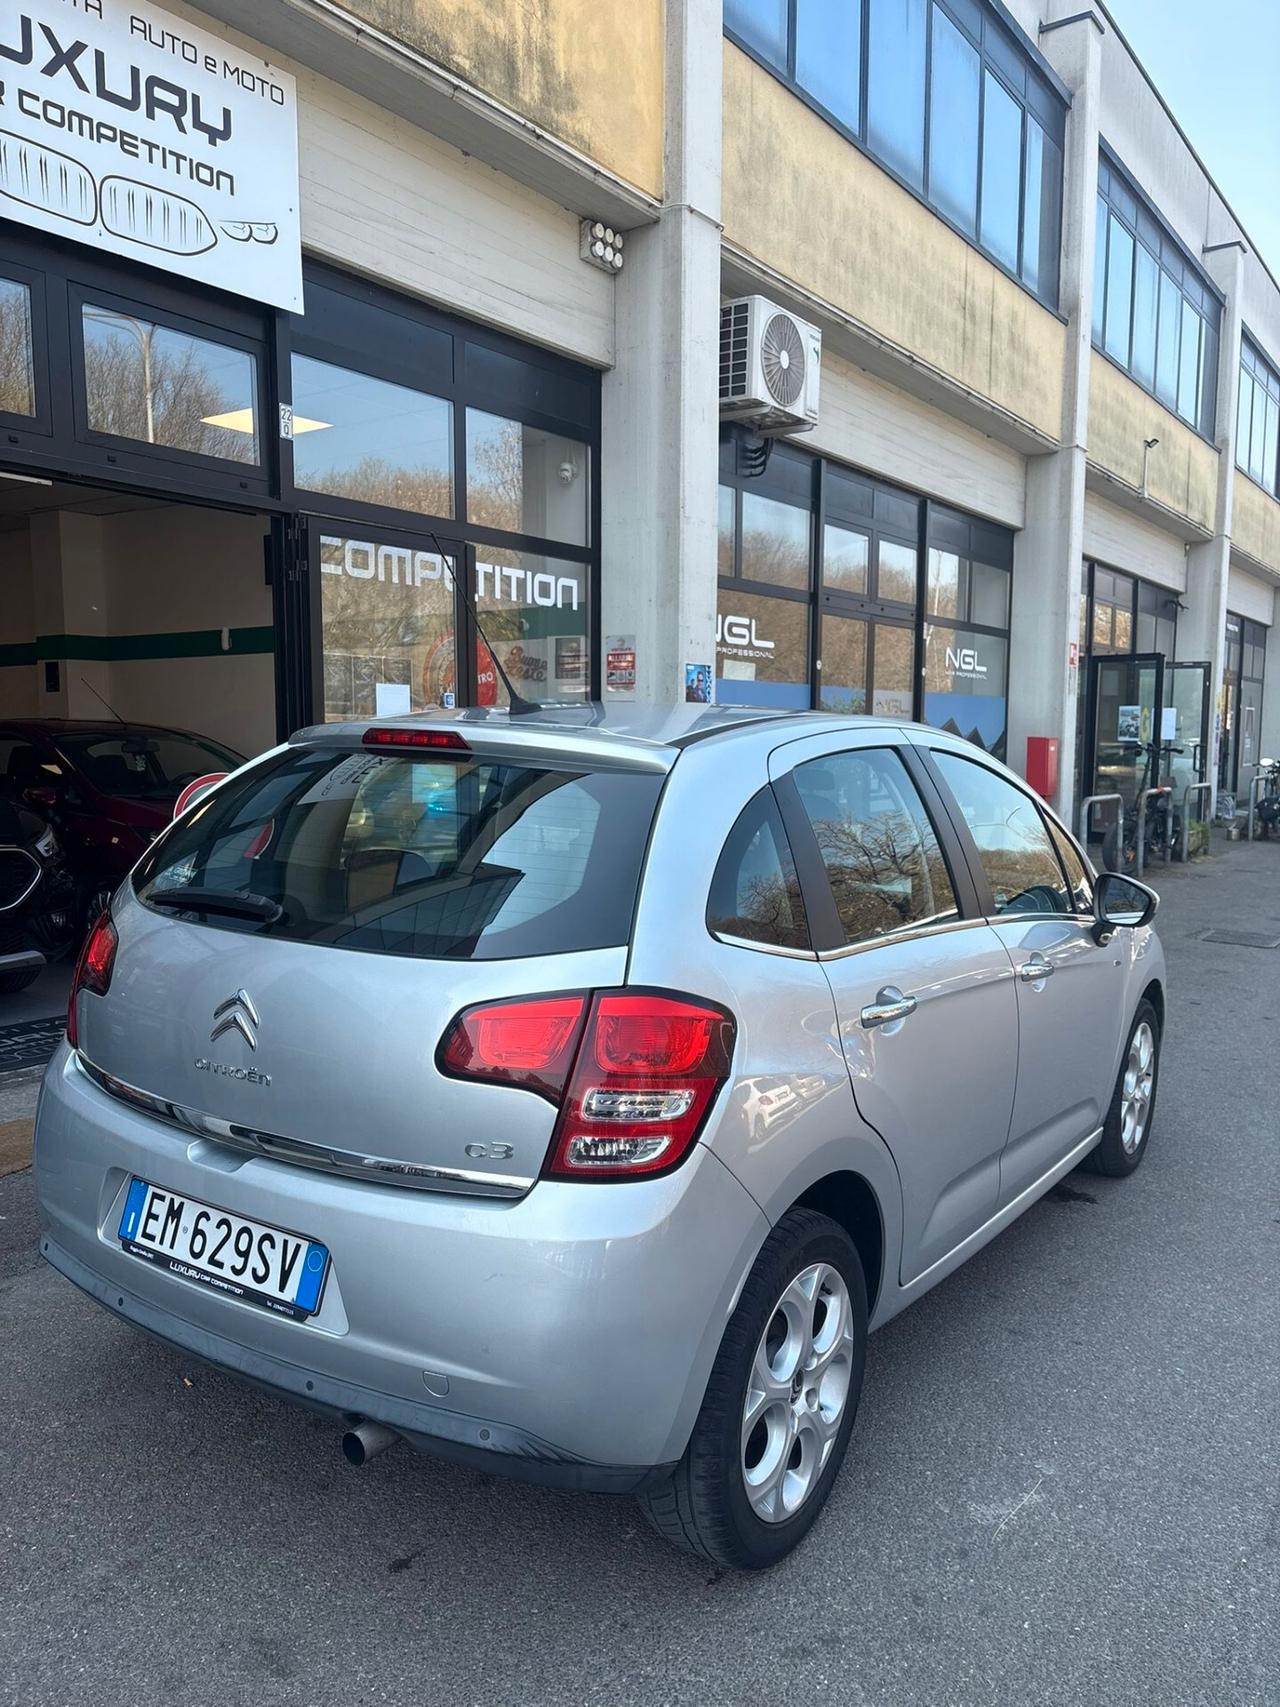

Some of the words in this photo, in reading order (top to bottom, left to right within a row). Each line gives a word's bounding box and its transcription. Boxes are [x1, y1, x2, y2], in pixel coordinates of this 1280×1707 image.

[130, 15, 197, 64] AUTO
[204, 55, 217, 75] e
[223, 61, 284, 106] MOTO
[18, 87, 235, 196] COMPETITION
[281, 408, 291, 422] 22
[716, 614, 775, 649] GL
[945, 647, 988, 672] NGL
[194, 1058, 272, 1087] CITROËN
[464, 1141, 514, 1160] C3
[140, 1191, 186, 1250] EM
[188, 1210, 302, 1294] 629SV
[169, 1261, 201, 1280] LUXURY
[210, 1278, 244, 1296] COMPETITION
